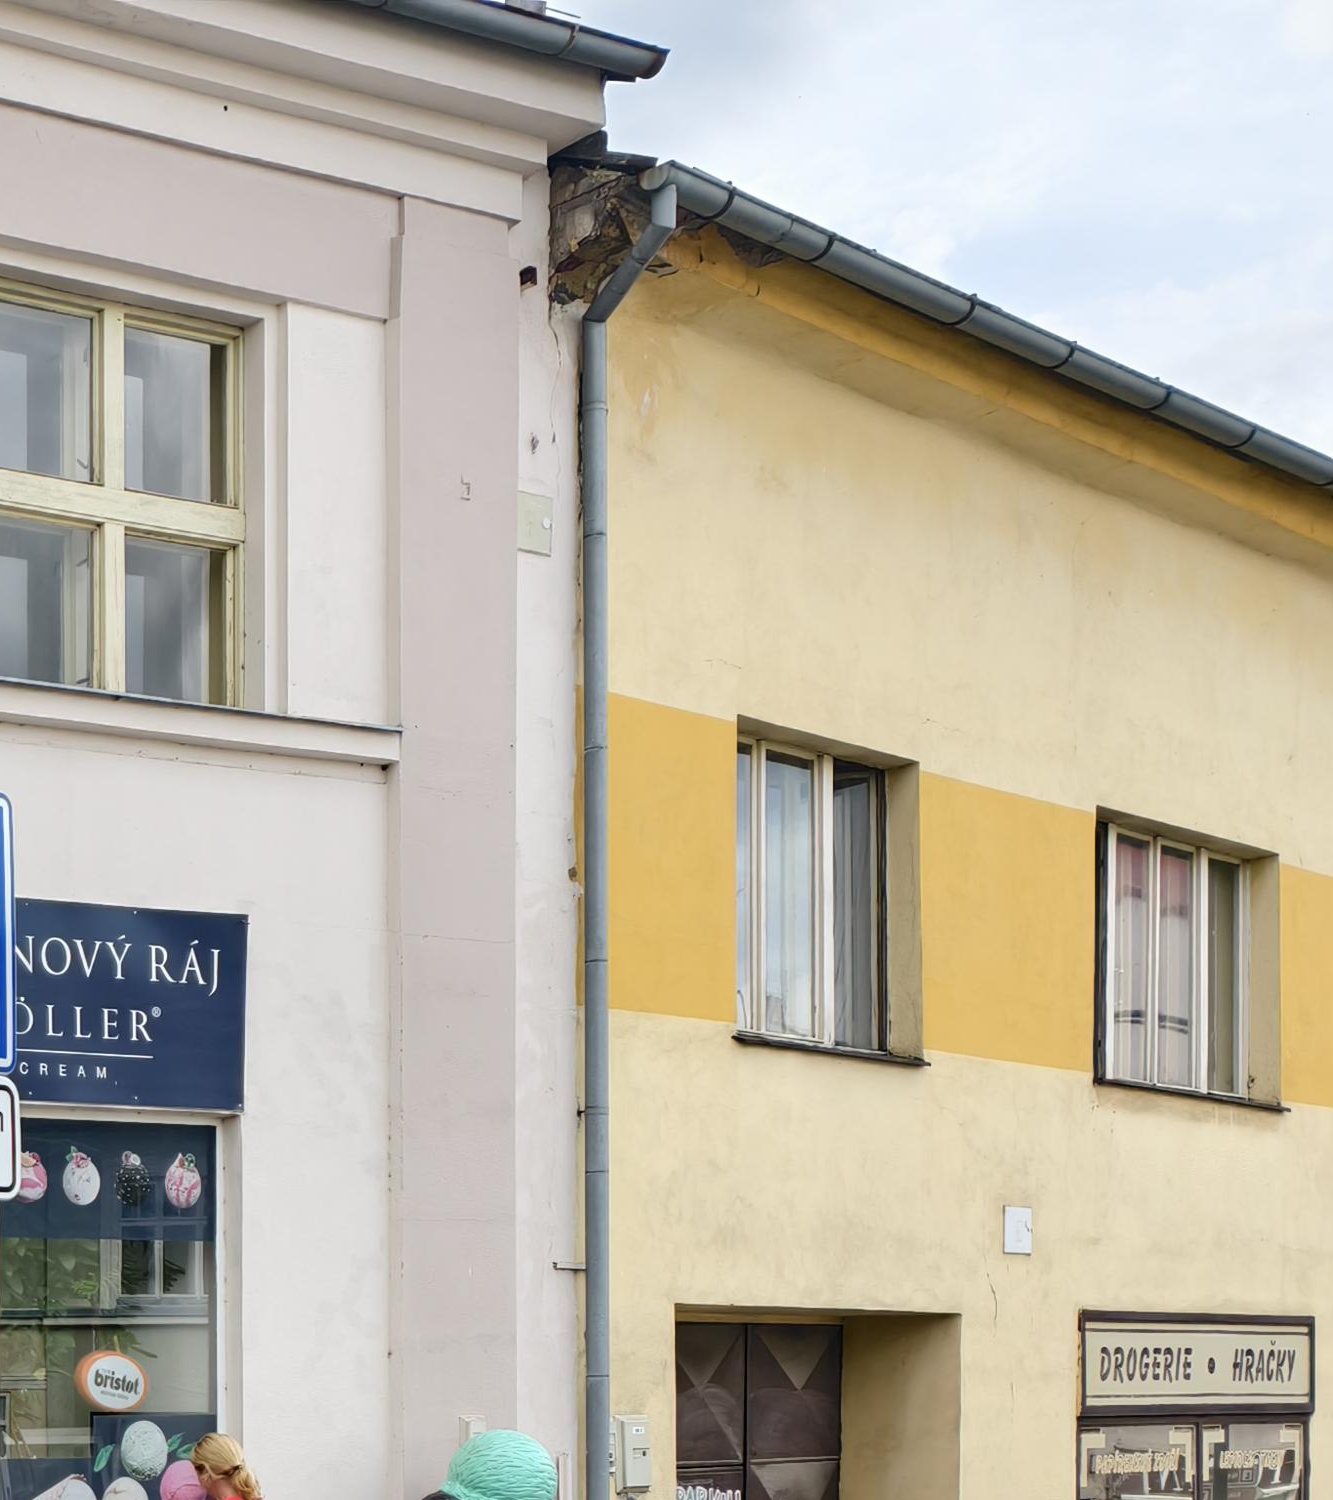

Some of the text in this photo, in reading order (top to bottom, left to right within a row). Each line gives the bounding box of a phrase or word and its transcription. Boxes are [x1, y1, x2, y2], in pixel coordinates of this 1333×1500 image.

[148, 940, 222, 997] RÁJ
[19, 1062, 107, 1079] CREAM
[1099, 1340, 1296, 1384] DROGERIE HRAČKY
[94, 1369, 139, 1395] bristot
